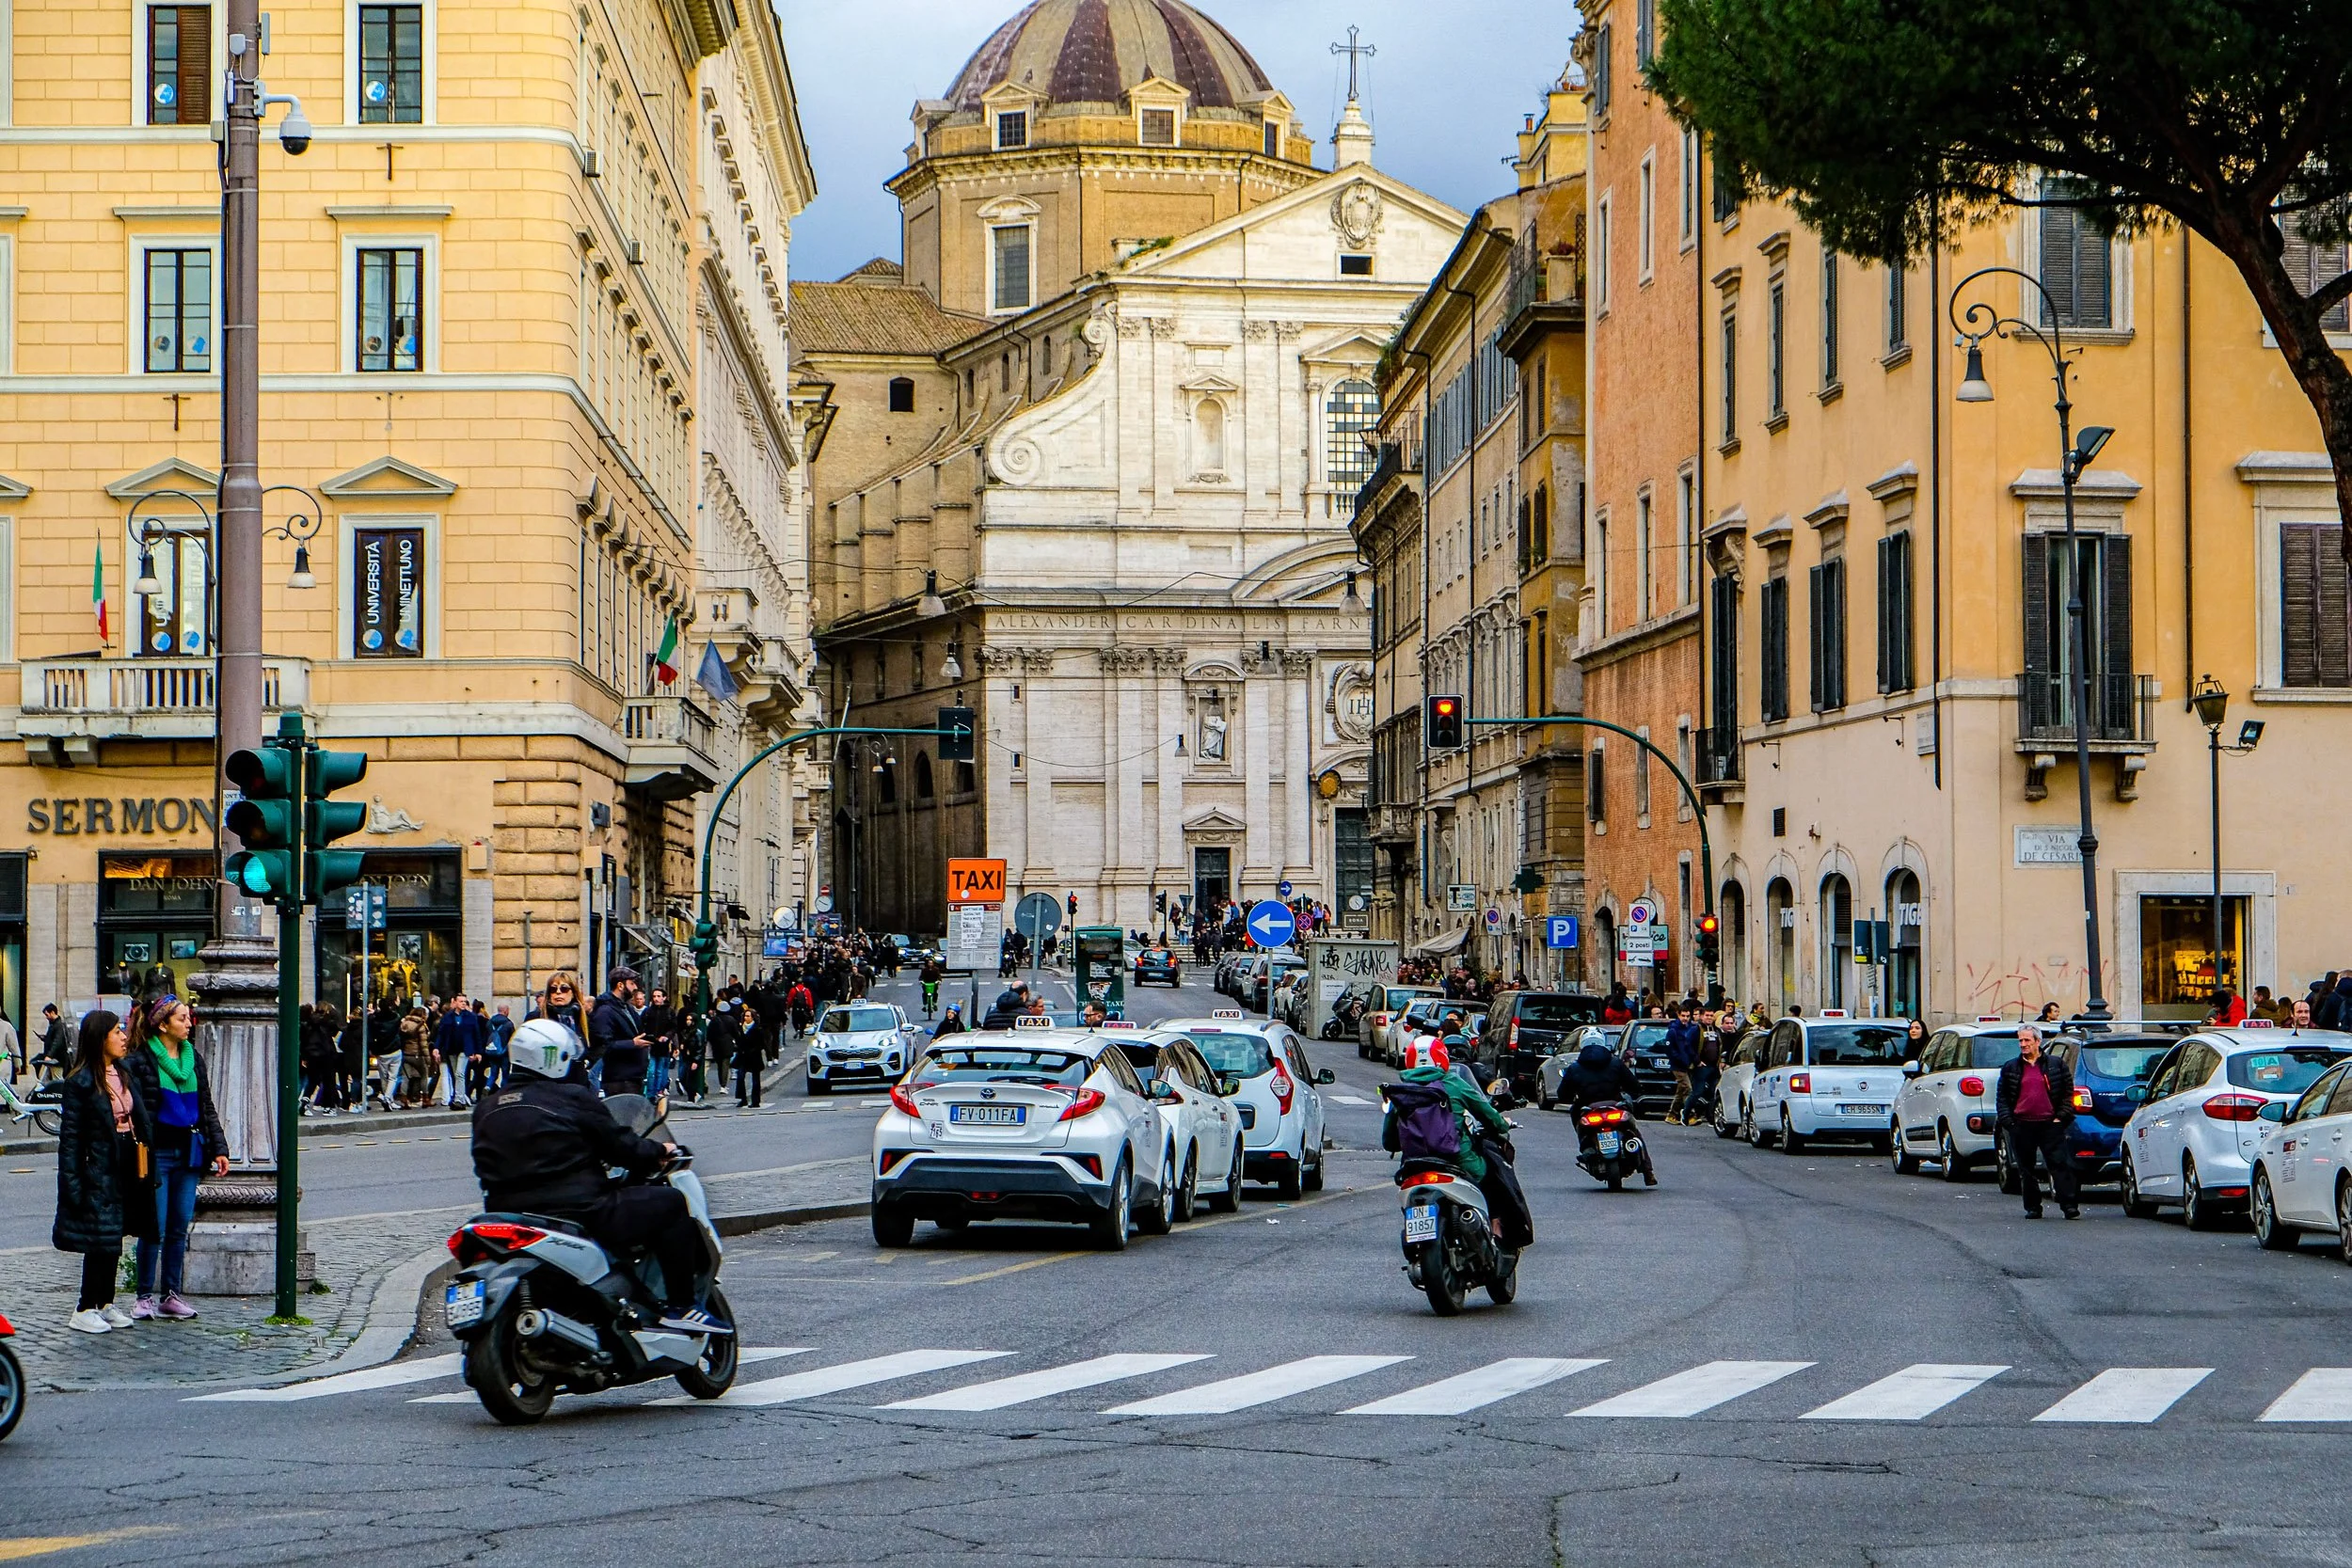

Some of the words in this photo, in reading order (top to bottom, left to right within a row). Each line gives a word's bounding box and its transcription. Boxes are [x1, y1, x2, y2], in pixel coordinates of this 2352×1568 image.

[365, 541, 380, 625] UNIVERSITÀ
[399, 539, 413, 624] UNINETTUNO
[995, 614, 1111, 628] ALEXANDER
[2047, 834, 2066, 844] VIA
[2024, 851, 2038, 861] DE
[130, 878, 165, 892] DAN
[951, 870, 1002, 890] TAXI
[1019, 1018, 1049, 1026] TAXI
[959, 1108, 974, 1120] FV
[978, 1108, 1017, 1122] 011FA
[1413, 1208, 1424, 1219] DN
[1407, 1219, 1435, 1233] 91857
